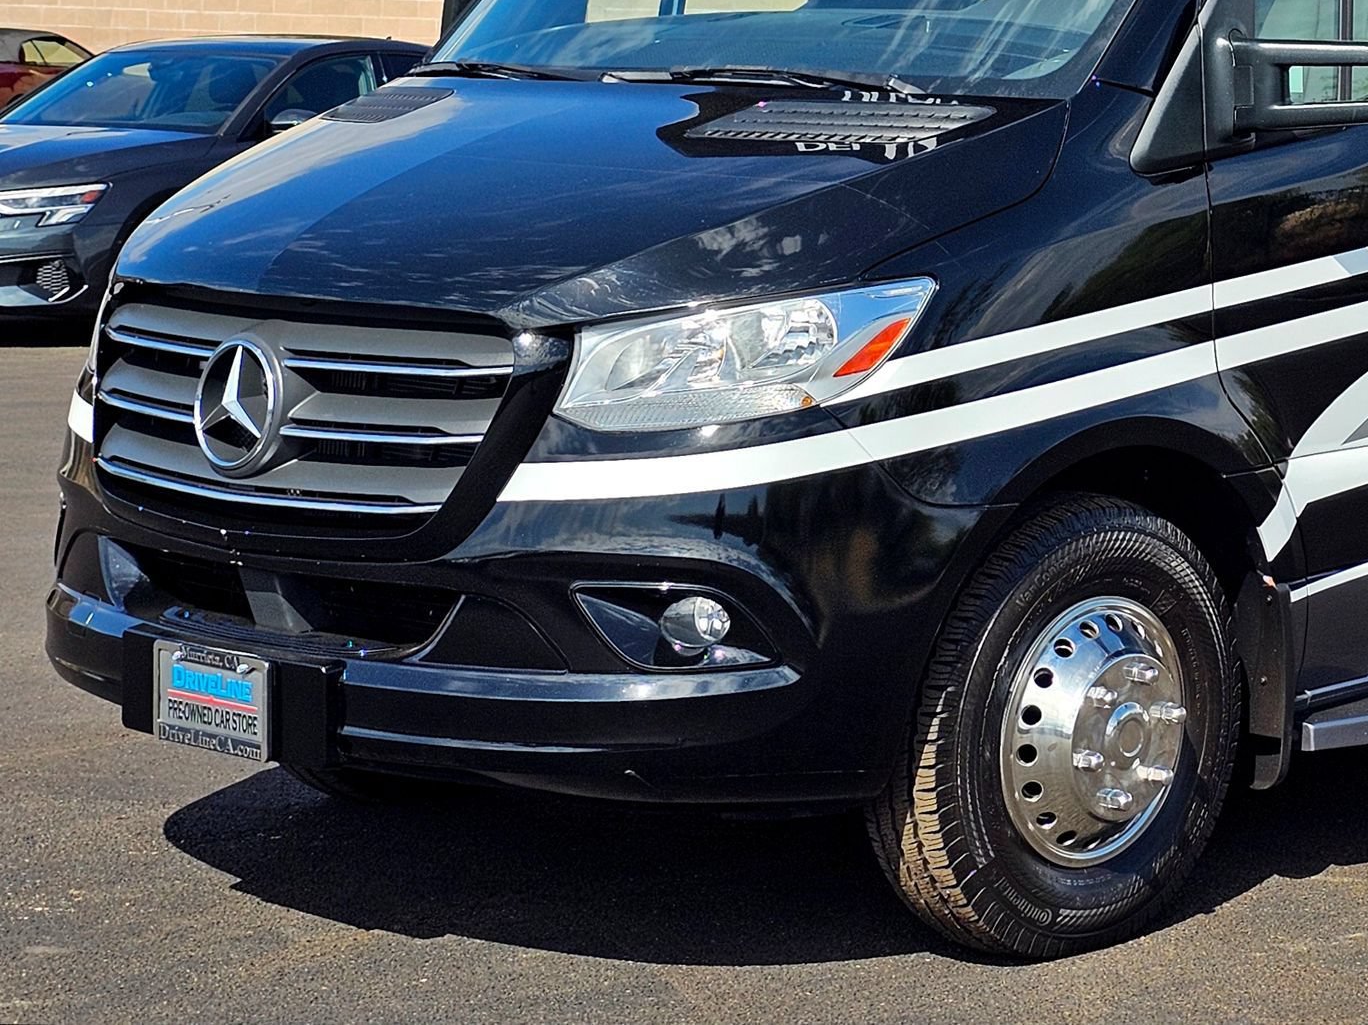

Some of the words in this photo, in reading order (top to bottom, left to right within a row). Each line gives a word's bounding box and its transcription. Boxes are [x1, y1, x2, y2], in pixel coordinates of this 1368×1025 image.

[168, 699, 212, 725] PRE-OWNED
[214, 709, 230, 730] CAR
[232, 713, 258, 736] STORE
[160, 724, 261, 759] DriveLineCA.com
